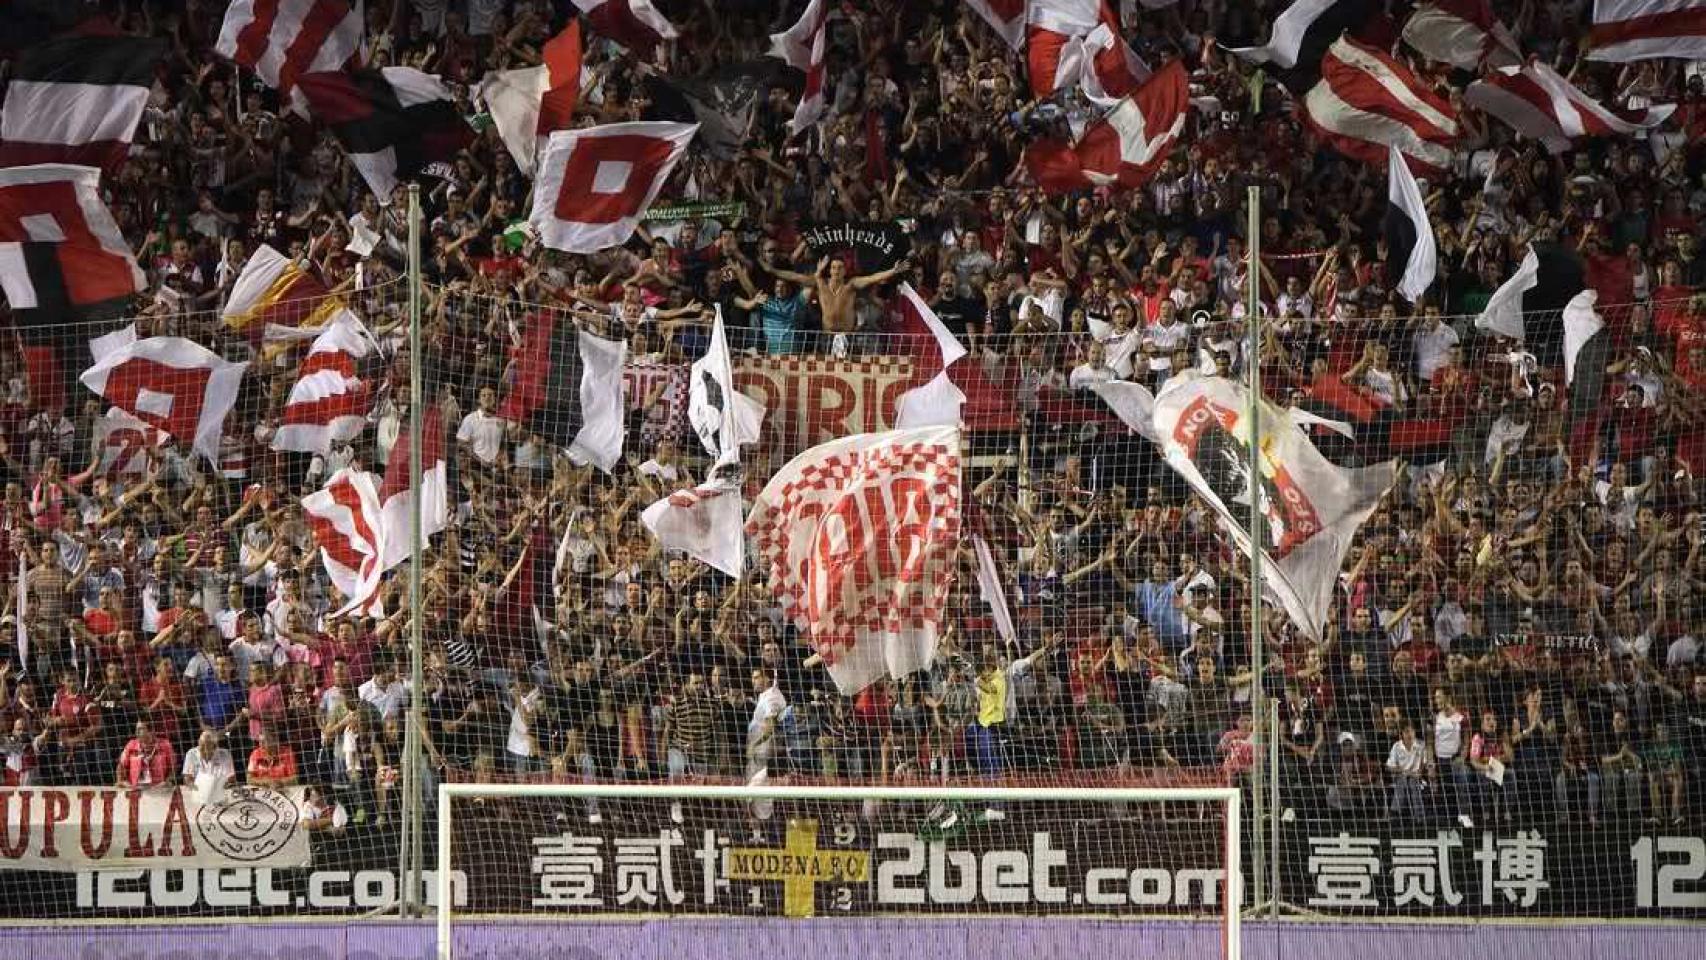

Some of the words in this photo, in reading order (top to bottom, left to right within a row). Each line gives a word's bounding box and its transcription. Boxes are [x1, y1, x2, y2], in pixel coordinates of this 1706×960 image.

[733, 855, 821, 876] MODENA
[1308, 829, 1550, 908] 壹贰博
[1630, 835, 1706, 908] 12
